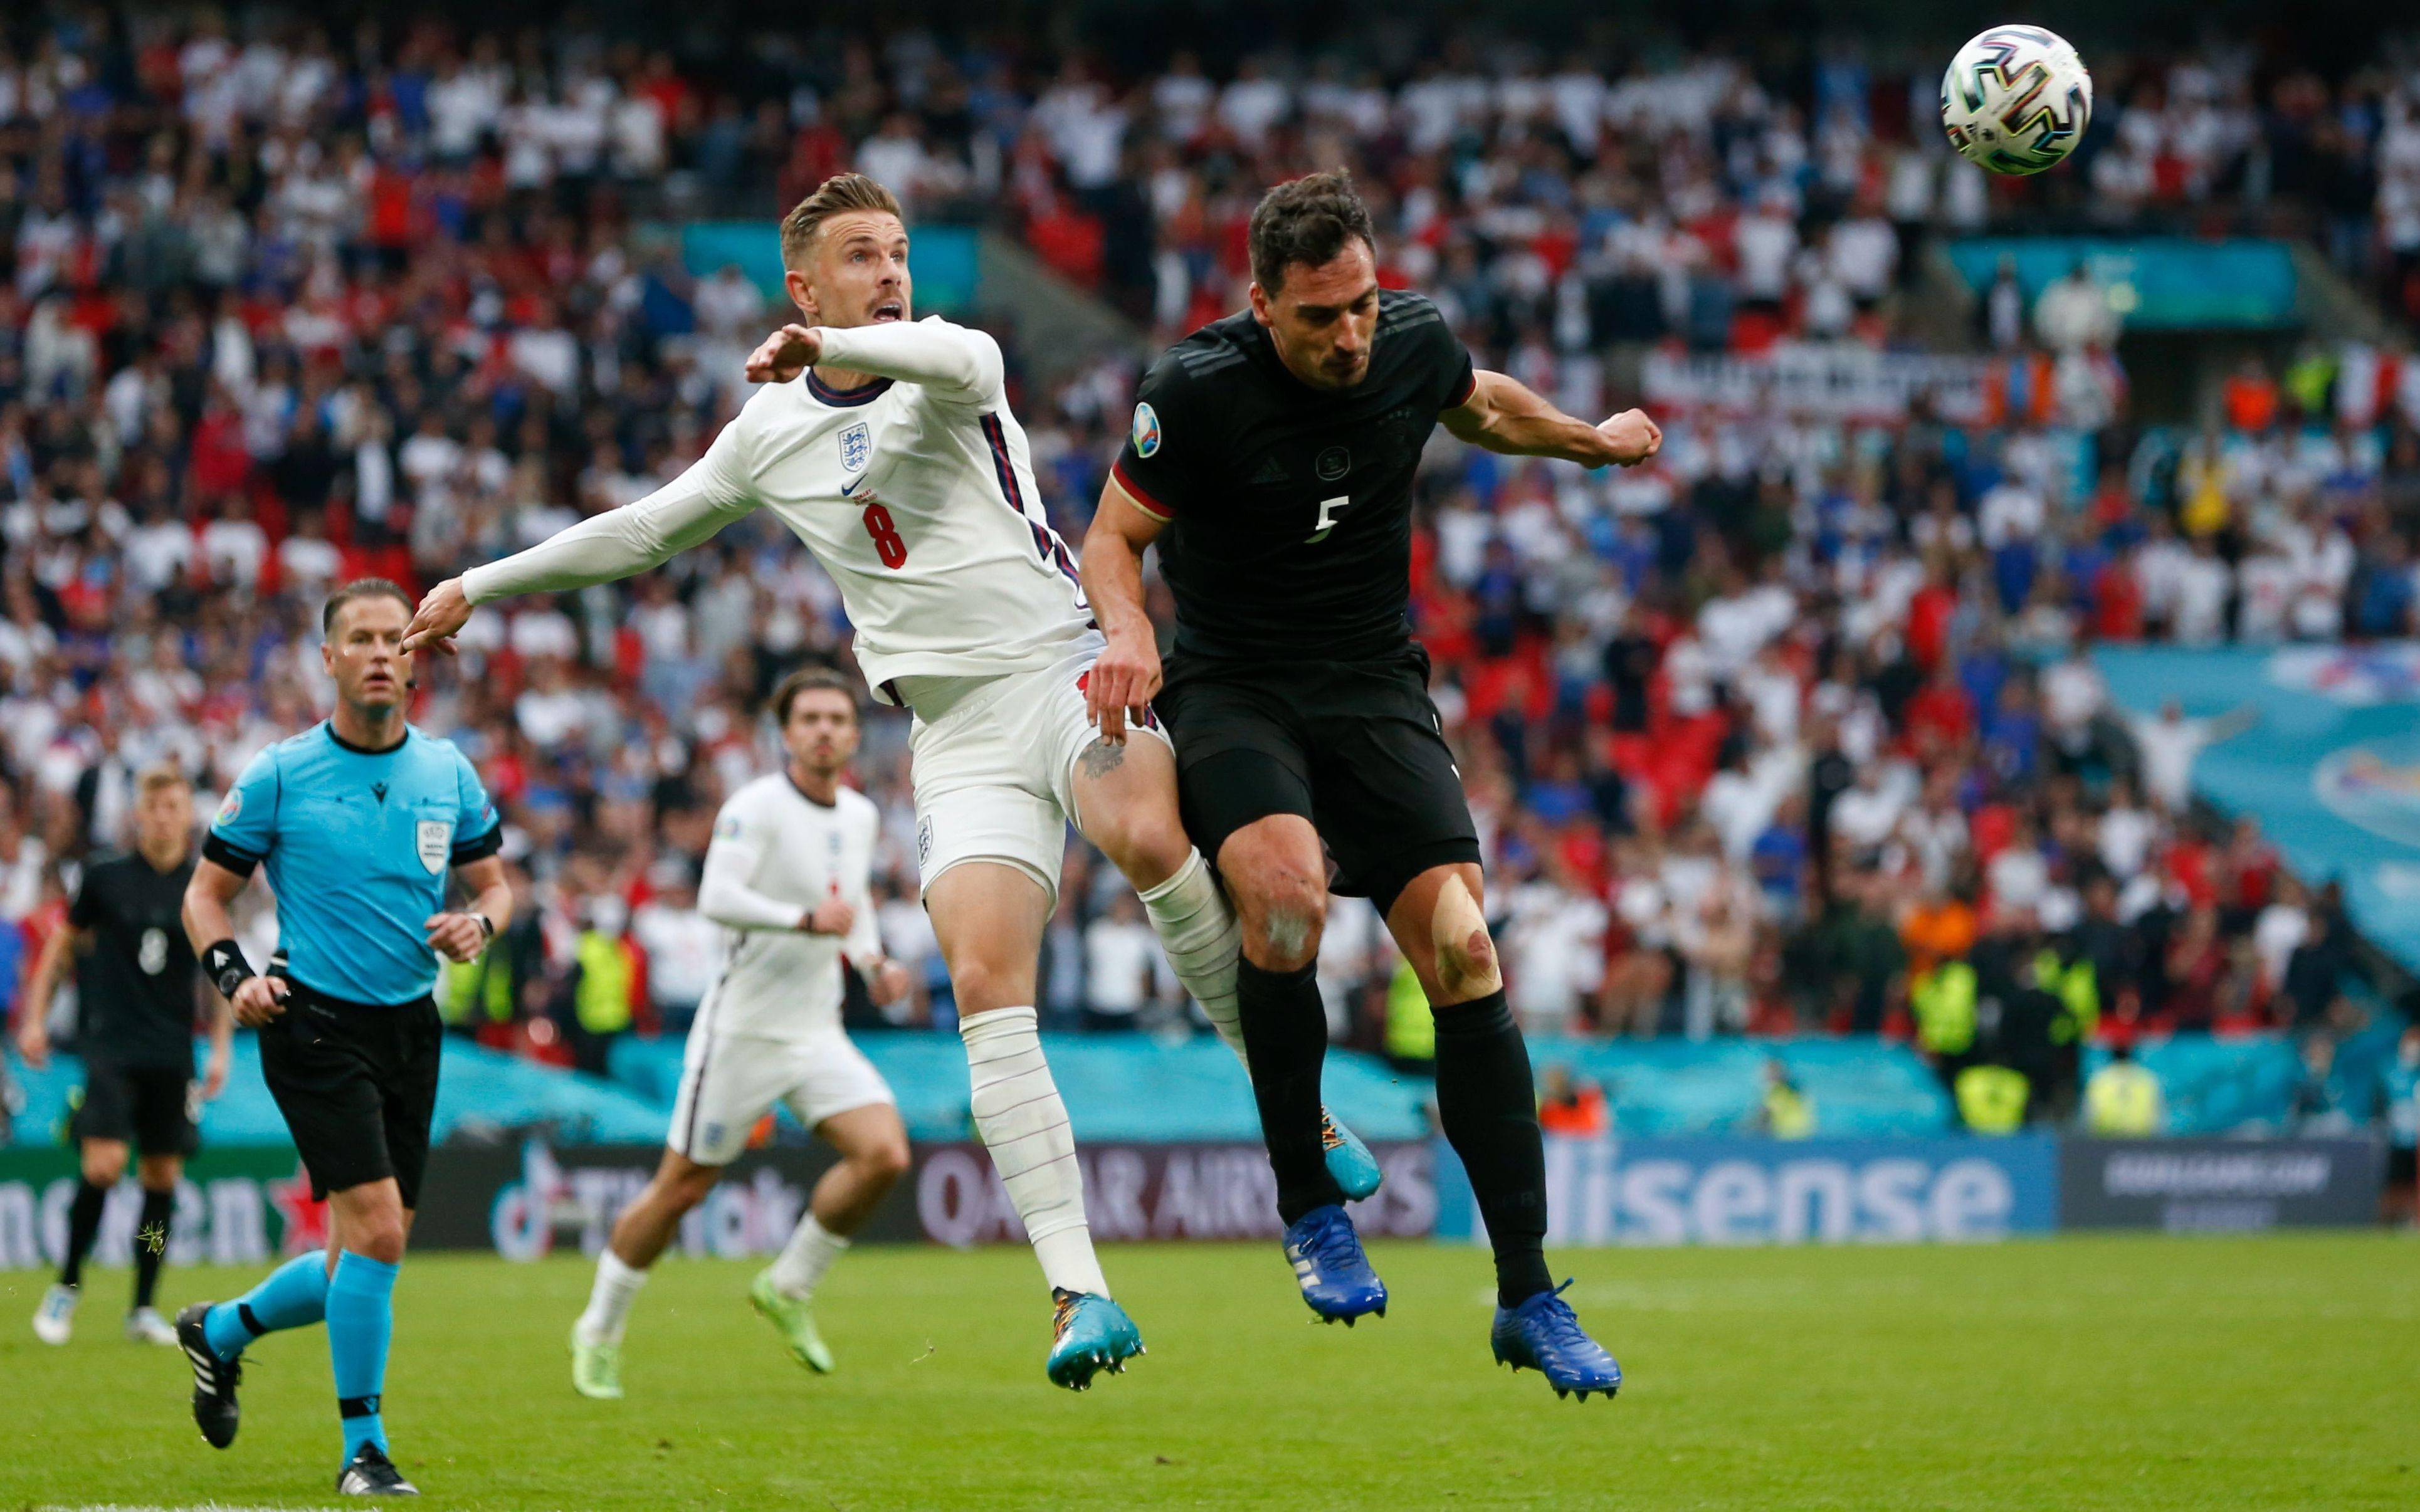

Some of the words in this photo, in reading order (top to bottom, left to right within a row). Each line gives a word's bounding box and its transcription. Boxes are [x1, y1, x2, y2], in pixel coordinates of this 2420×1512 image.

[862, 503, 908, 570] 8
[1303, 495, 1350, 544] 5
[917, 1150, 1149, 1251] QAR
[1152, 1146, 1437, 1236] AIRS
